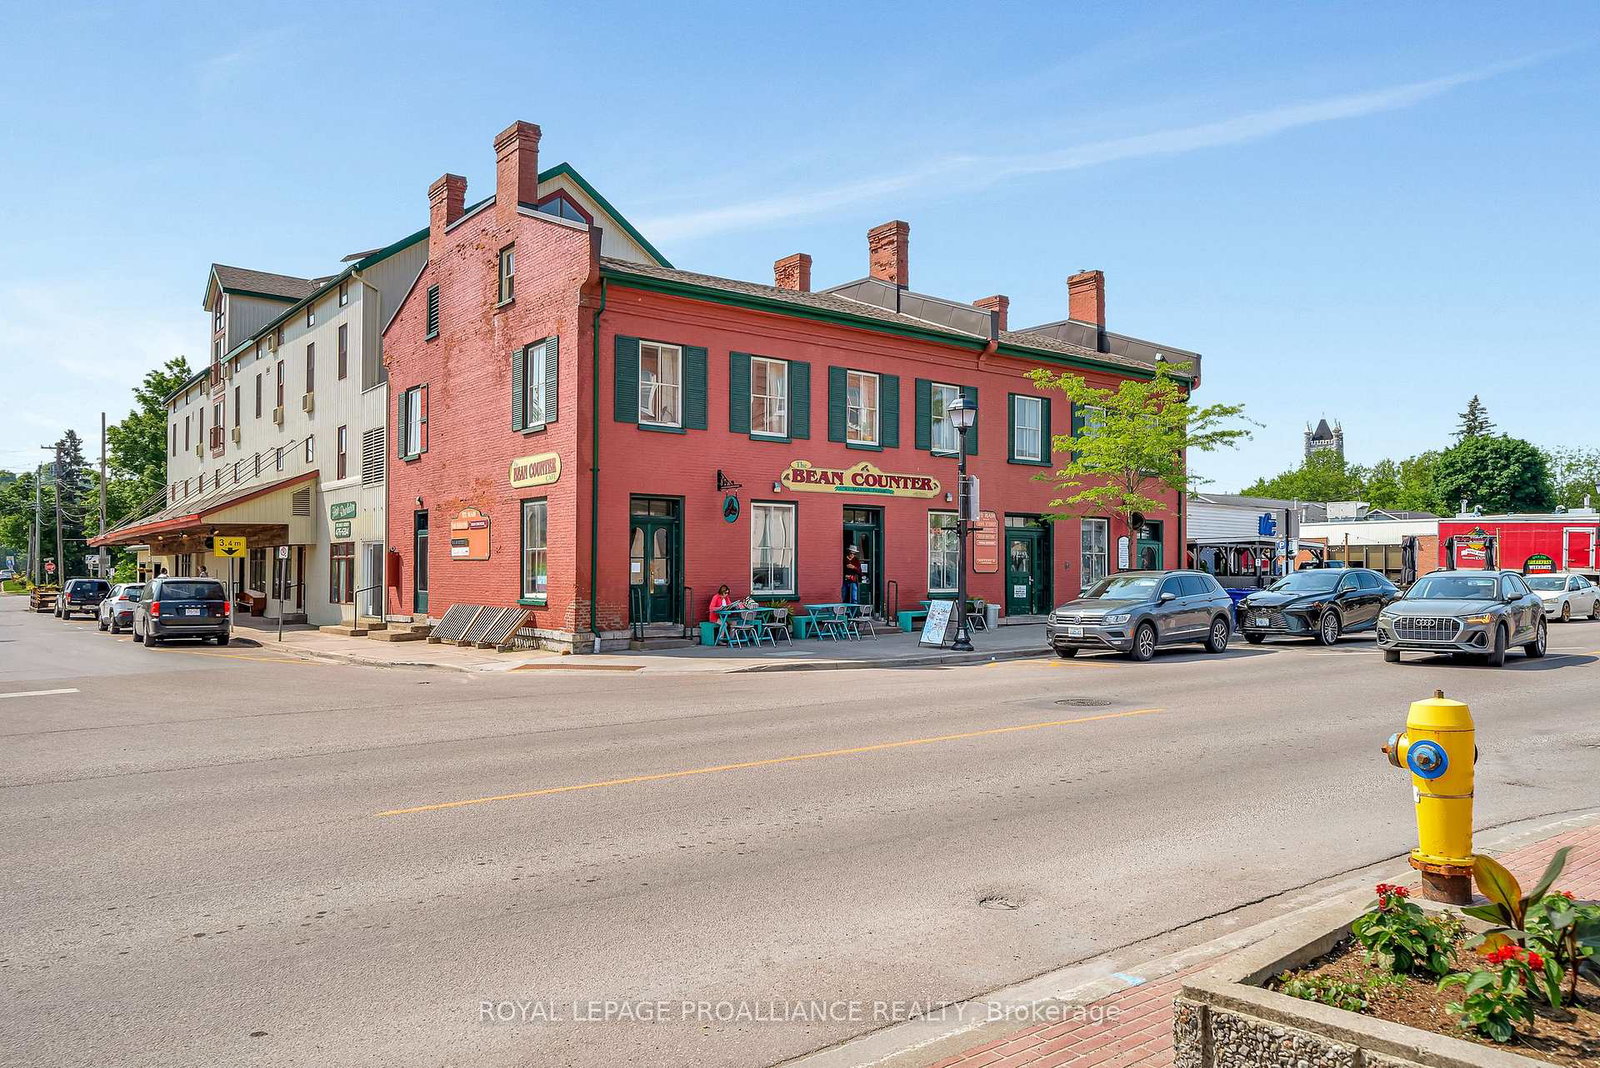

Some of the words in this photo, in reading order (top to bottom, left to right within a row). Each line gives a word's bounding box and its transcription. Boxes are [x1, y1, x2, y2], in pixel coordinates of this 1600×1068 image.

[513, 464, 528, 482] BEAN
[529, 457, 557, 479] COUNTER
[791, 468, 844, 485] BEAN
[851, 472, 933, 491] COUNTER
[219, 538, 233, 547] 3.4
